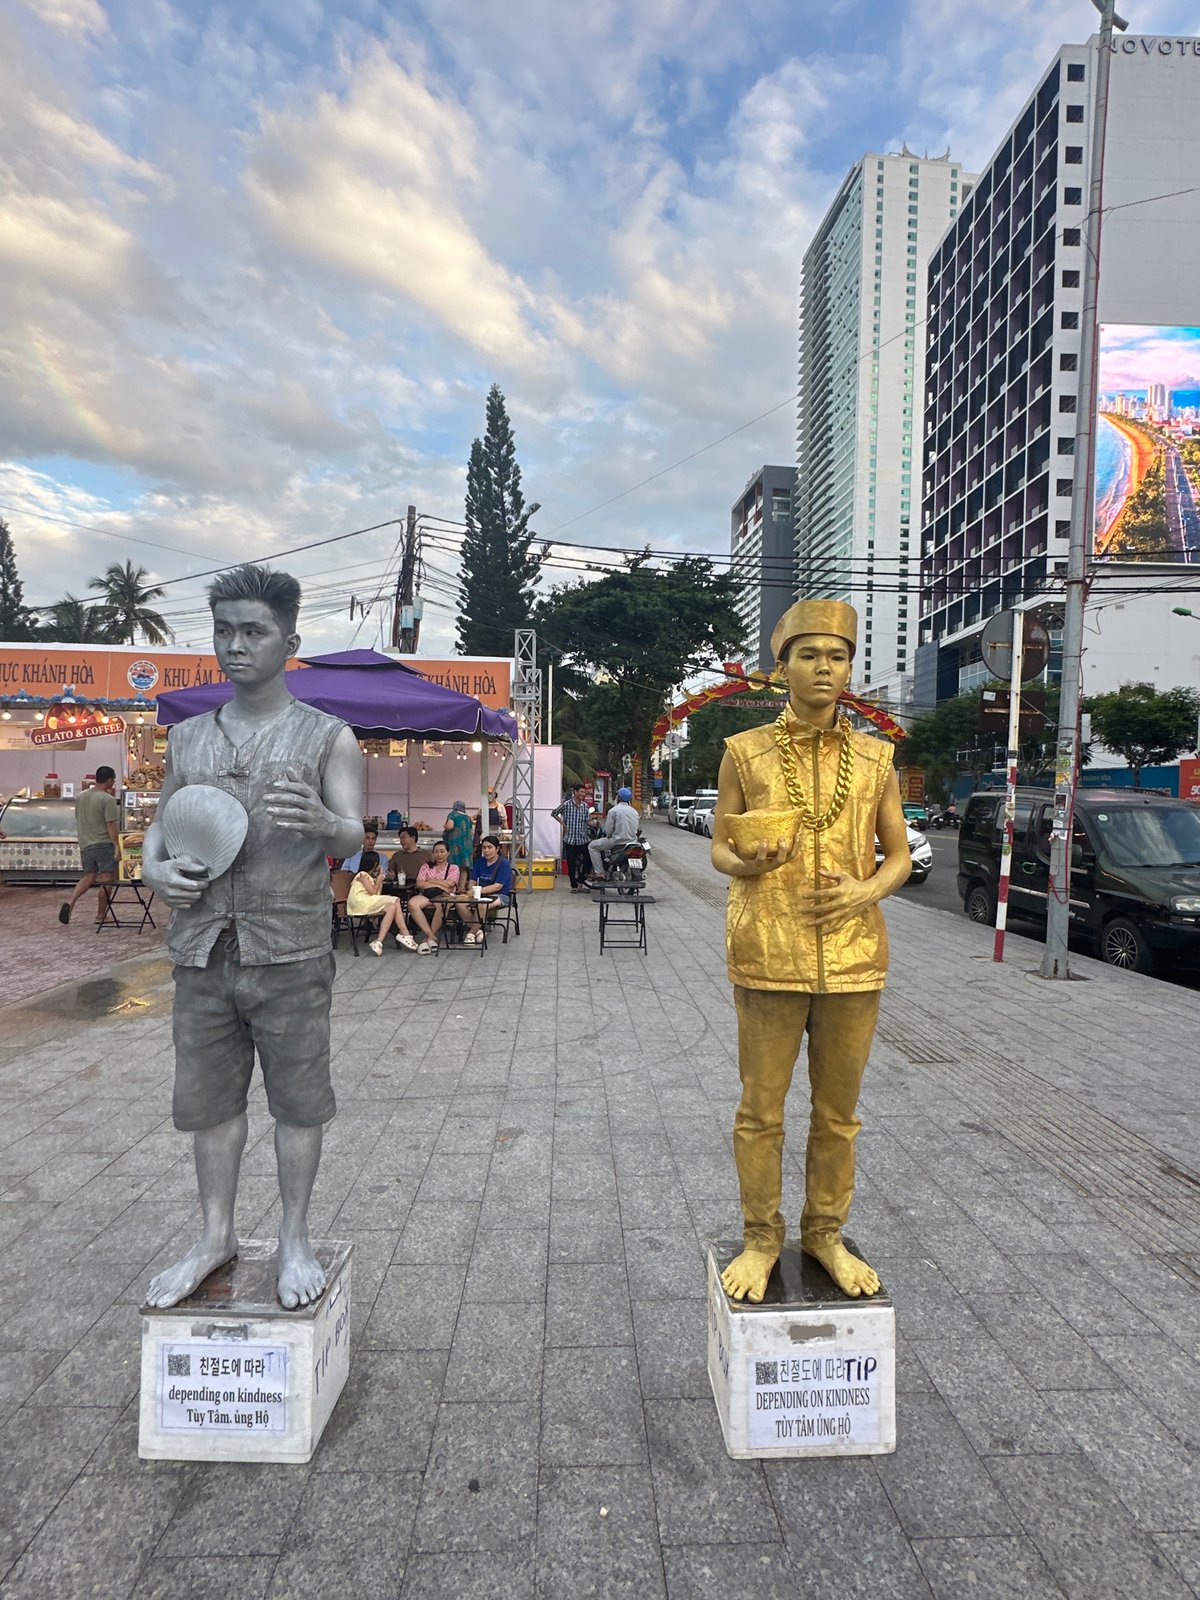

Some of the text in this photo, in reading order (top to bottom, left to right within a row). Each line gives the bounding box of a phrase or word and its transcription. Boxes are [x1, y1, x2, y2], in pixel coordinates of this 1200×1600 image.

[22, 658, 67, 684] KHÁNH
[70, 658, 95, 684] HÒA
[164, 668, 191, 687] KHU
[194, 658, 213, 687] ẨM
[473, 670, 497, 695] HÒA
[34, 730, 73, 744] GELATO
[75, 729, 84, 738] &
[85, 722, 123, 736] COFFEE
[199, 1357, 266, 1378] 친절도에 따라
[315, 1337, 331, 1395] TIP
[780, 1357, 846, 1383] 친절도에 따라
[168, 1385, 283, 1405] depending on kindness
[756, 1387, 870, 1410] DEPENDING ON KINDNESS
[187, 1408, 269, 1428] Tùy Tâm. ủng Hộ
[775, 1412, 851, 1439] TÙY TÂM ỦNG HỘ
